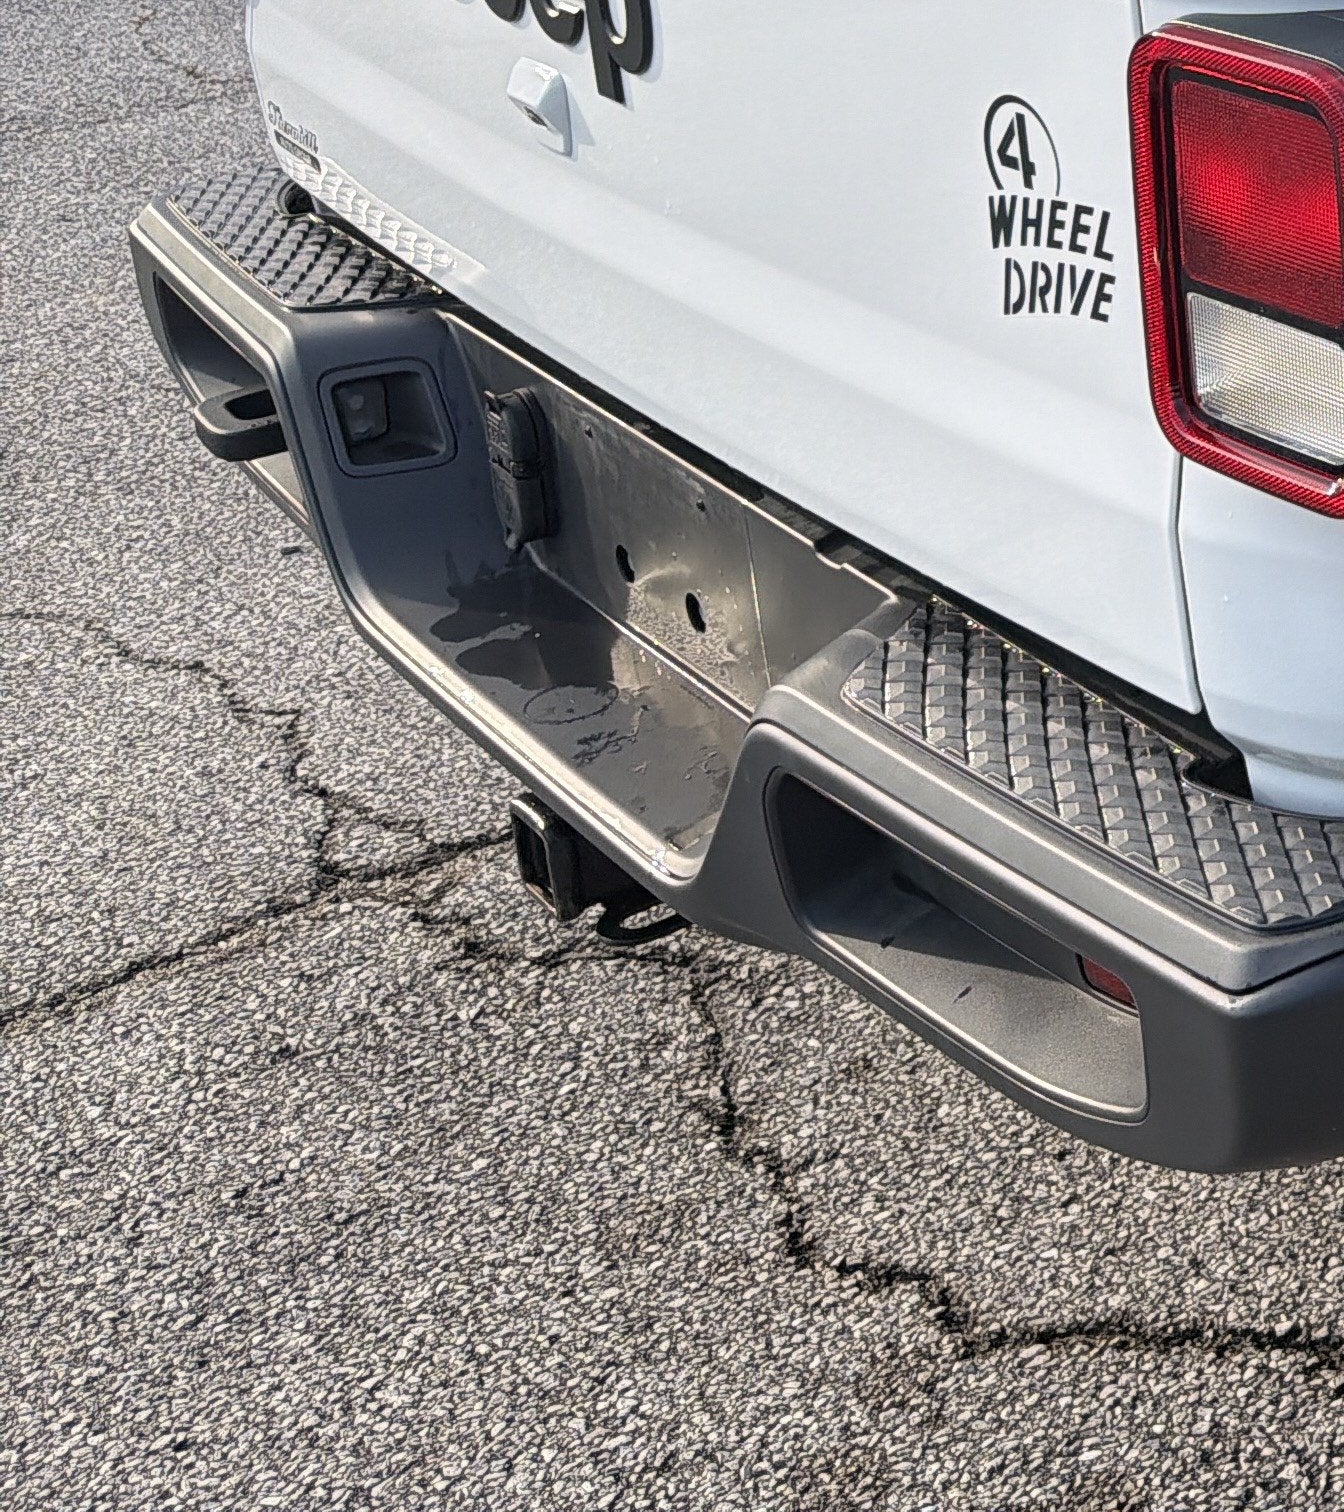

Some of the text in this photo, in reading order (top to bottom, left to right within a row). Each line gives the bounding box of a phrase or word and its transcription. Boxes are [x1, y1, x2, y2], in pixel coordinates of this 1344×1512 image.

[996, 111, 1037, 190] 4
[988, 194, 1115, 262] WHEEL
[1003, 257, 1117, 323] DRIVE
